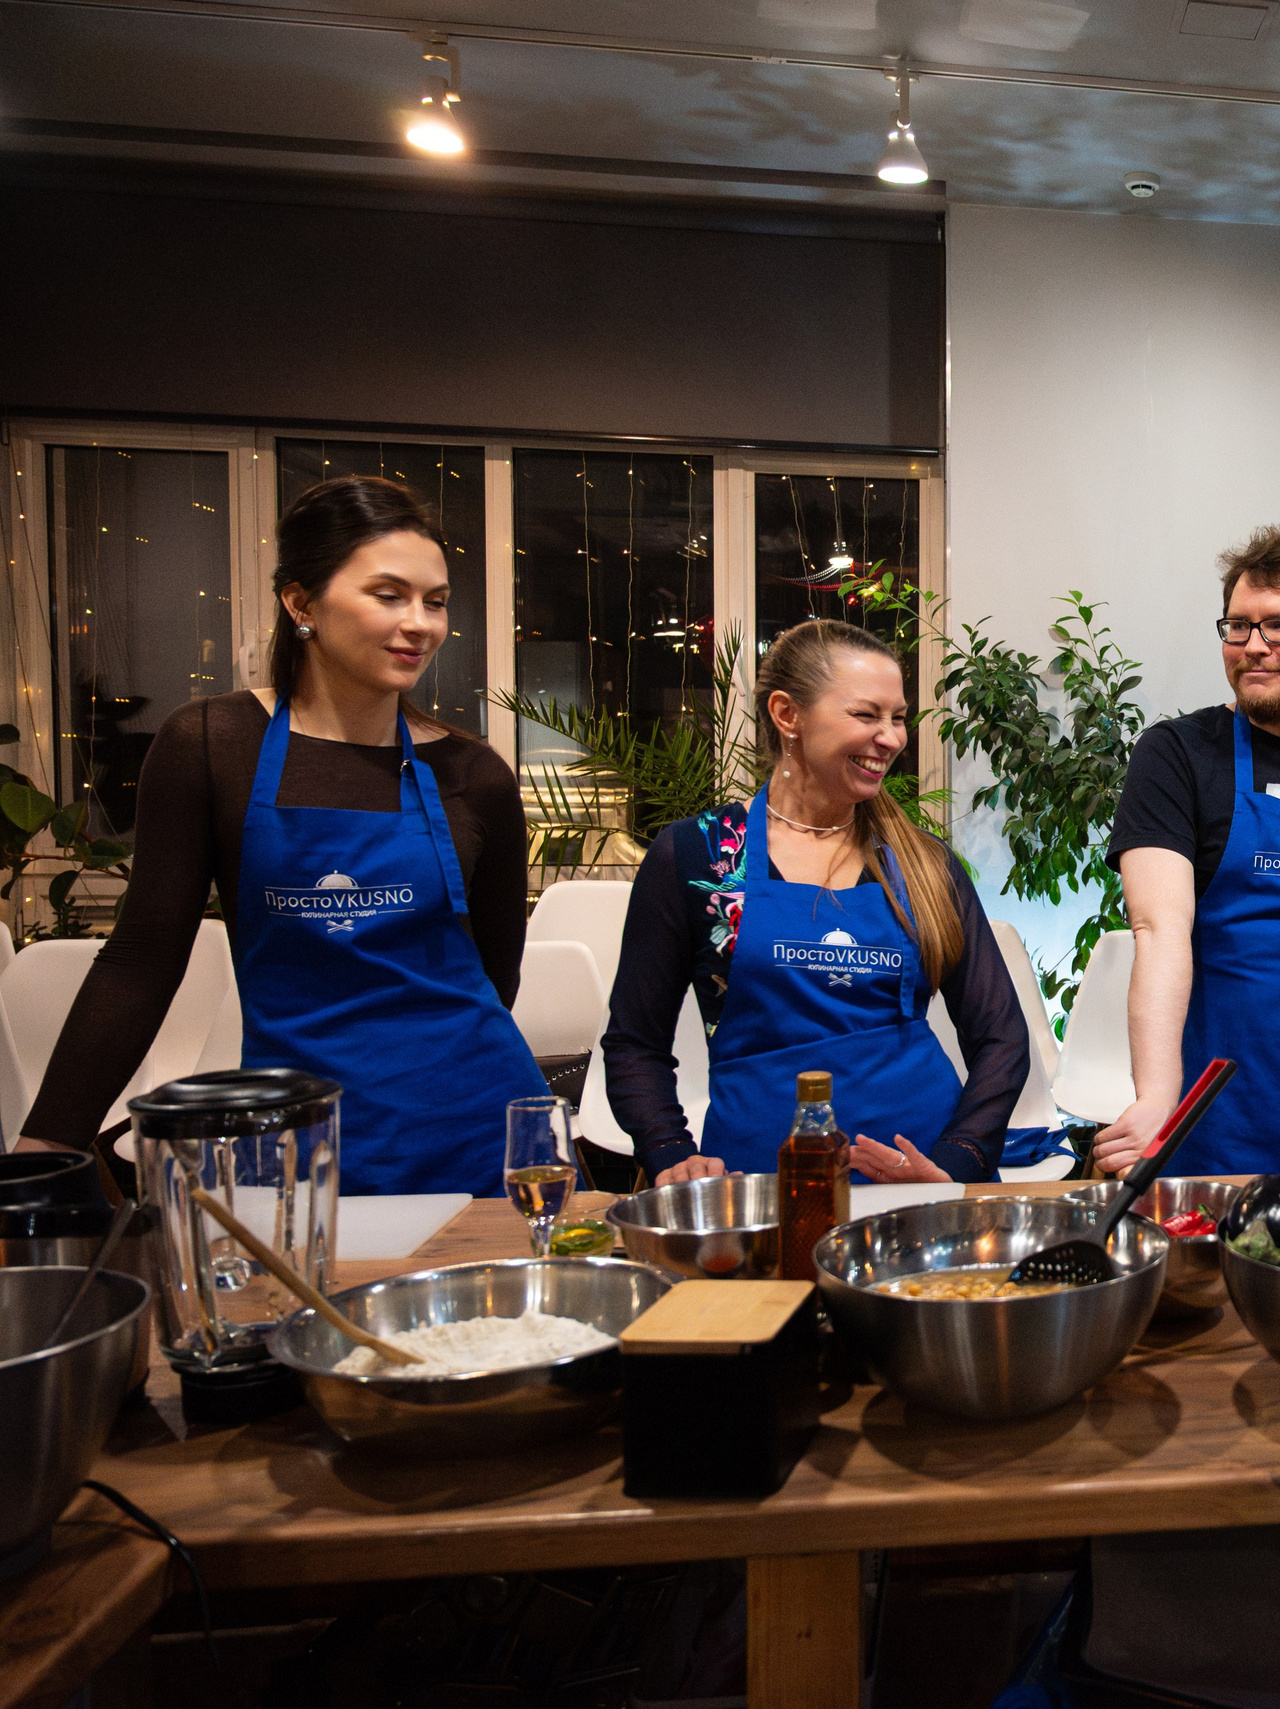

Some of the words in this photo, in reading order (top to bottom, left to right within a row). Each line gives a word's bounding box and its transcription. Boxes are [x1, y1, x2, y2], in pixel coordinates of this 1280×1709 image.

[265, 888, 413, 911] ПростоVKUSNO
[349, 909, 377, 918] СТУДИЯ
[773, 944, 902, 968] ПростоVKUSNO
